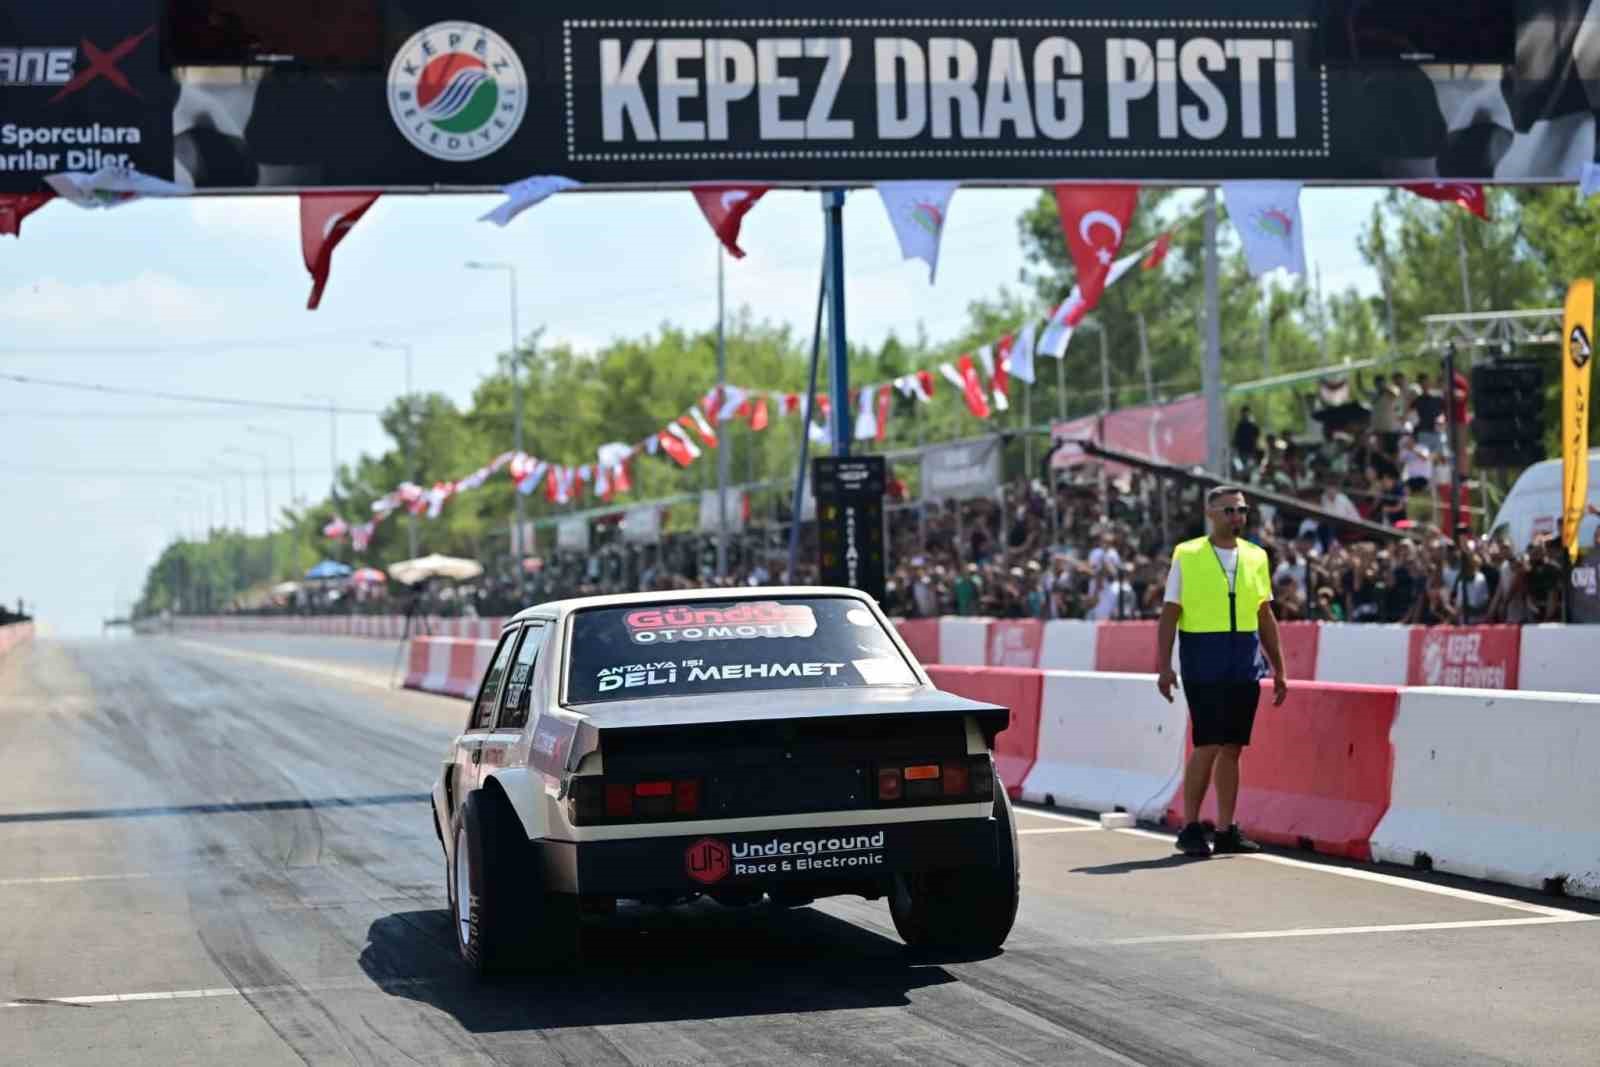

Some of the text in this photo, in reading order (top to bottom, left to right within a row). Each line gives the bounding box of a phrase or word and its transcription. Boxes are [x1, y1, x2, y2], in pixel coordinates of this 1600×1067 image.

[600, 37, 854, 142] KEPEZ
[874, 36, 1084, 140] DRAG
[1, 123, 141, 148] Sporculara
[597, 661, 677, 677] ANTALYA
[688, 662, 845, 681] MEHMET
[731, 831, 885, 856] Underground
[735, 853, 884, 876] Race & Electronic
